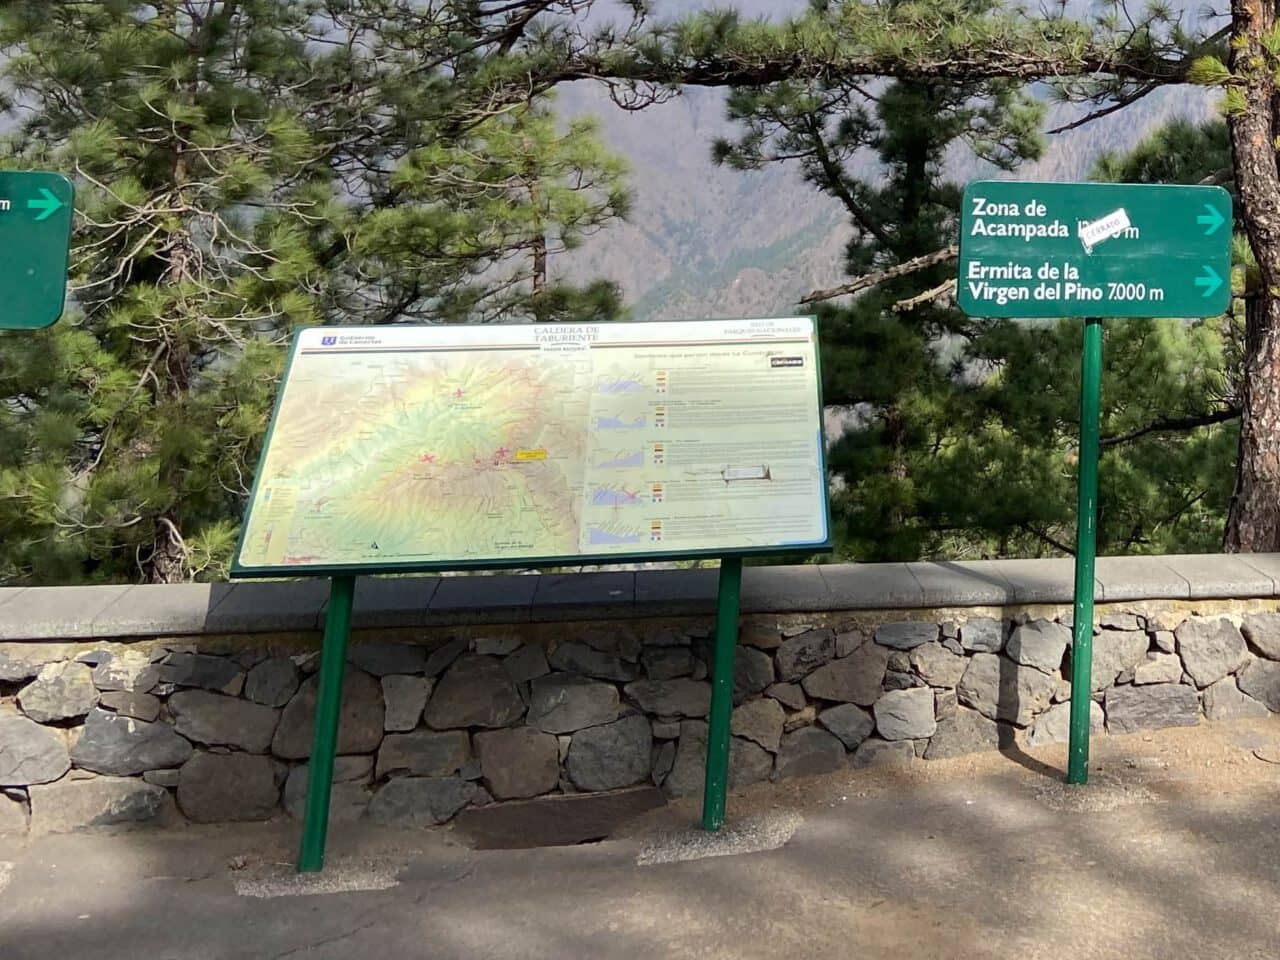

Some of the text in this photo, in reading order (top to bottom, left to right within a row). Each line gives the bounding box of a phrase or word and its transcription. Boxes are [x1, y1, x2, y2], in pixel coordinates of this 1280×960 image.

[972, 198, 1047, 217] Zona de
[971, 219, 1069, 241] Acampada
[1125, 225, 1140, 239] m
[968, 262, 1079, 280] Ermita de la
[968, 282, 1029, 304] Virgen
[1033, 282, 1061, 301] del
[1064, 283, 1103, 301] Pino
[1149, 287, 1164, 301] m
